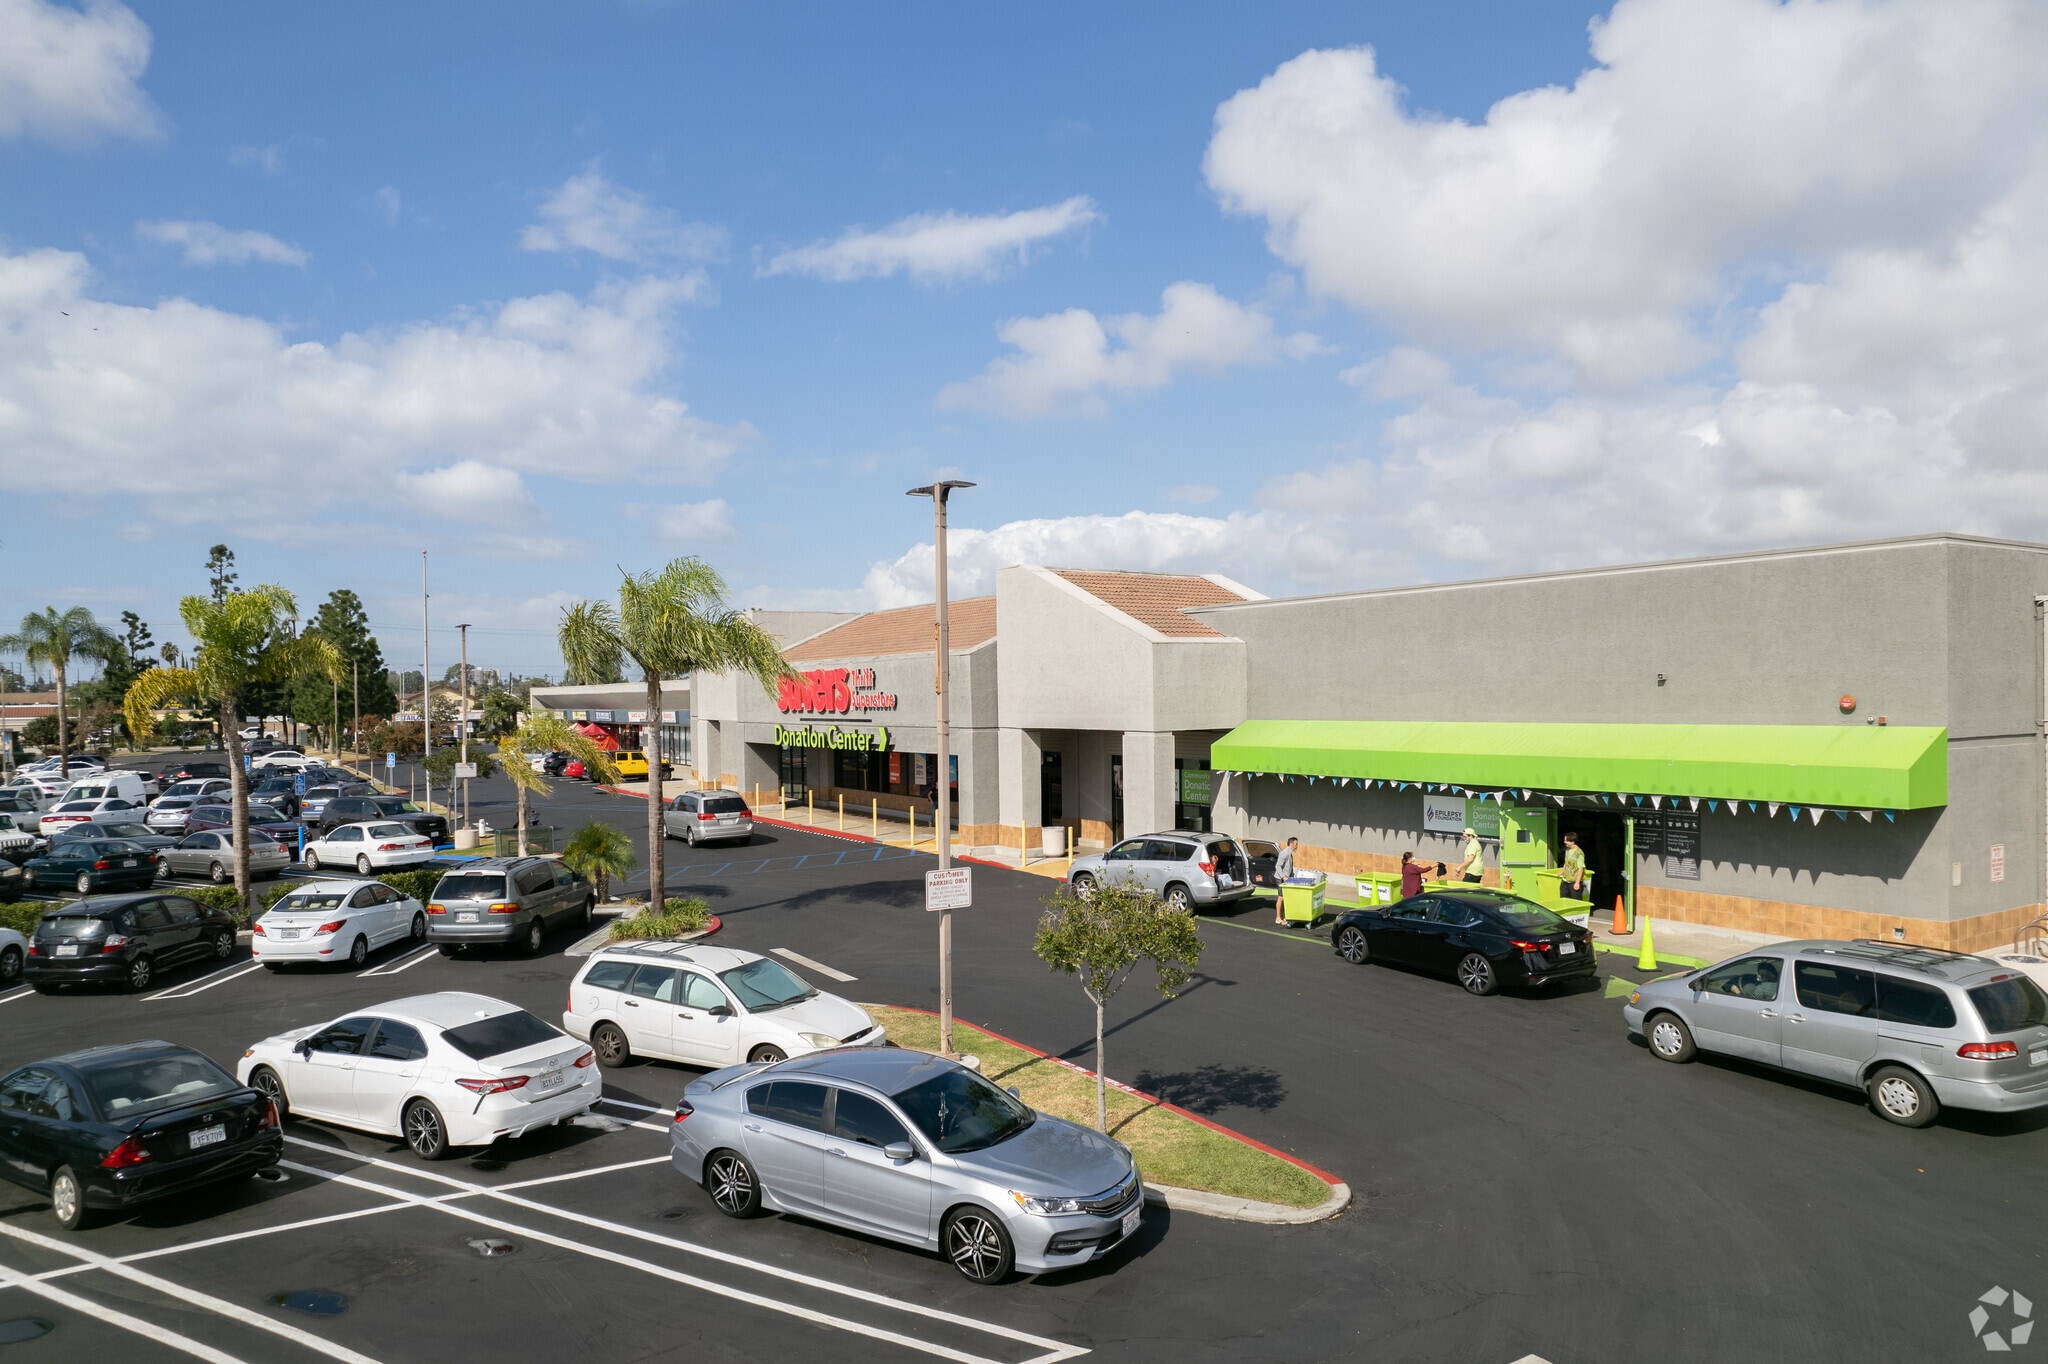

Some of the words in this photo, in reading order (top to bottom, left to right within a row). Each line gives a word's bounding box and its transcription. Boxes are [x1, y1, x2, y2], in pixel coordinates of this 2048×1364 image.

[851, 669, 874, 687] Thrift
[851, 690, 896, 710] Superstore
[774, 724, 825, 748] Donation
[827, 725, 873, 751] Center
[1185, 790, 1210, 801] Center
[1435, 809, 1462, 818] EPILEPSY
[1472, 820, 1498, 830] Center
[934, 871, 964, 880] CUSTOMER
[929, 879, 953, 887] PARKING
